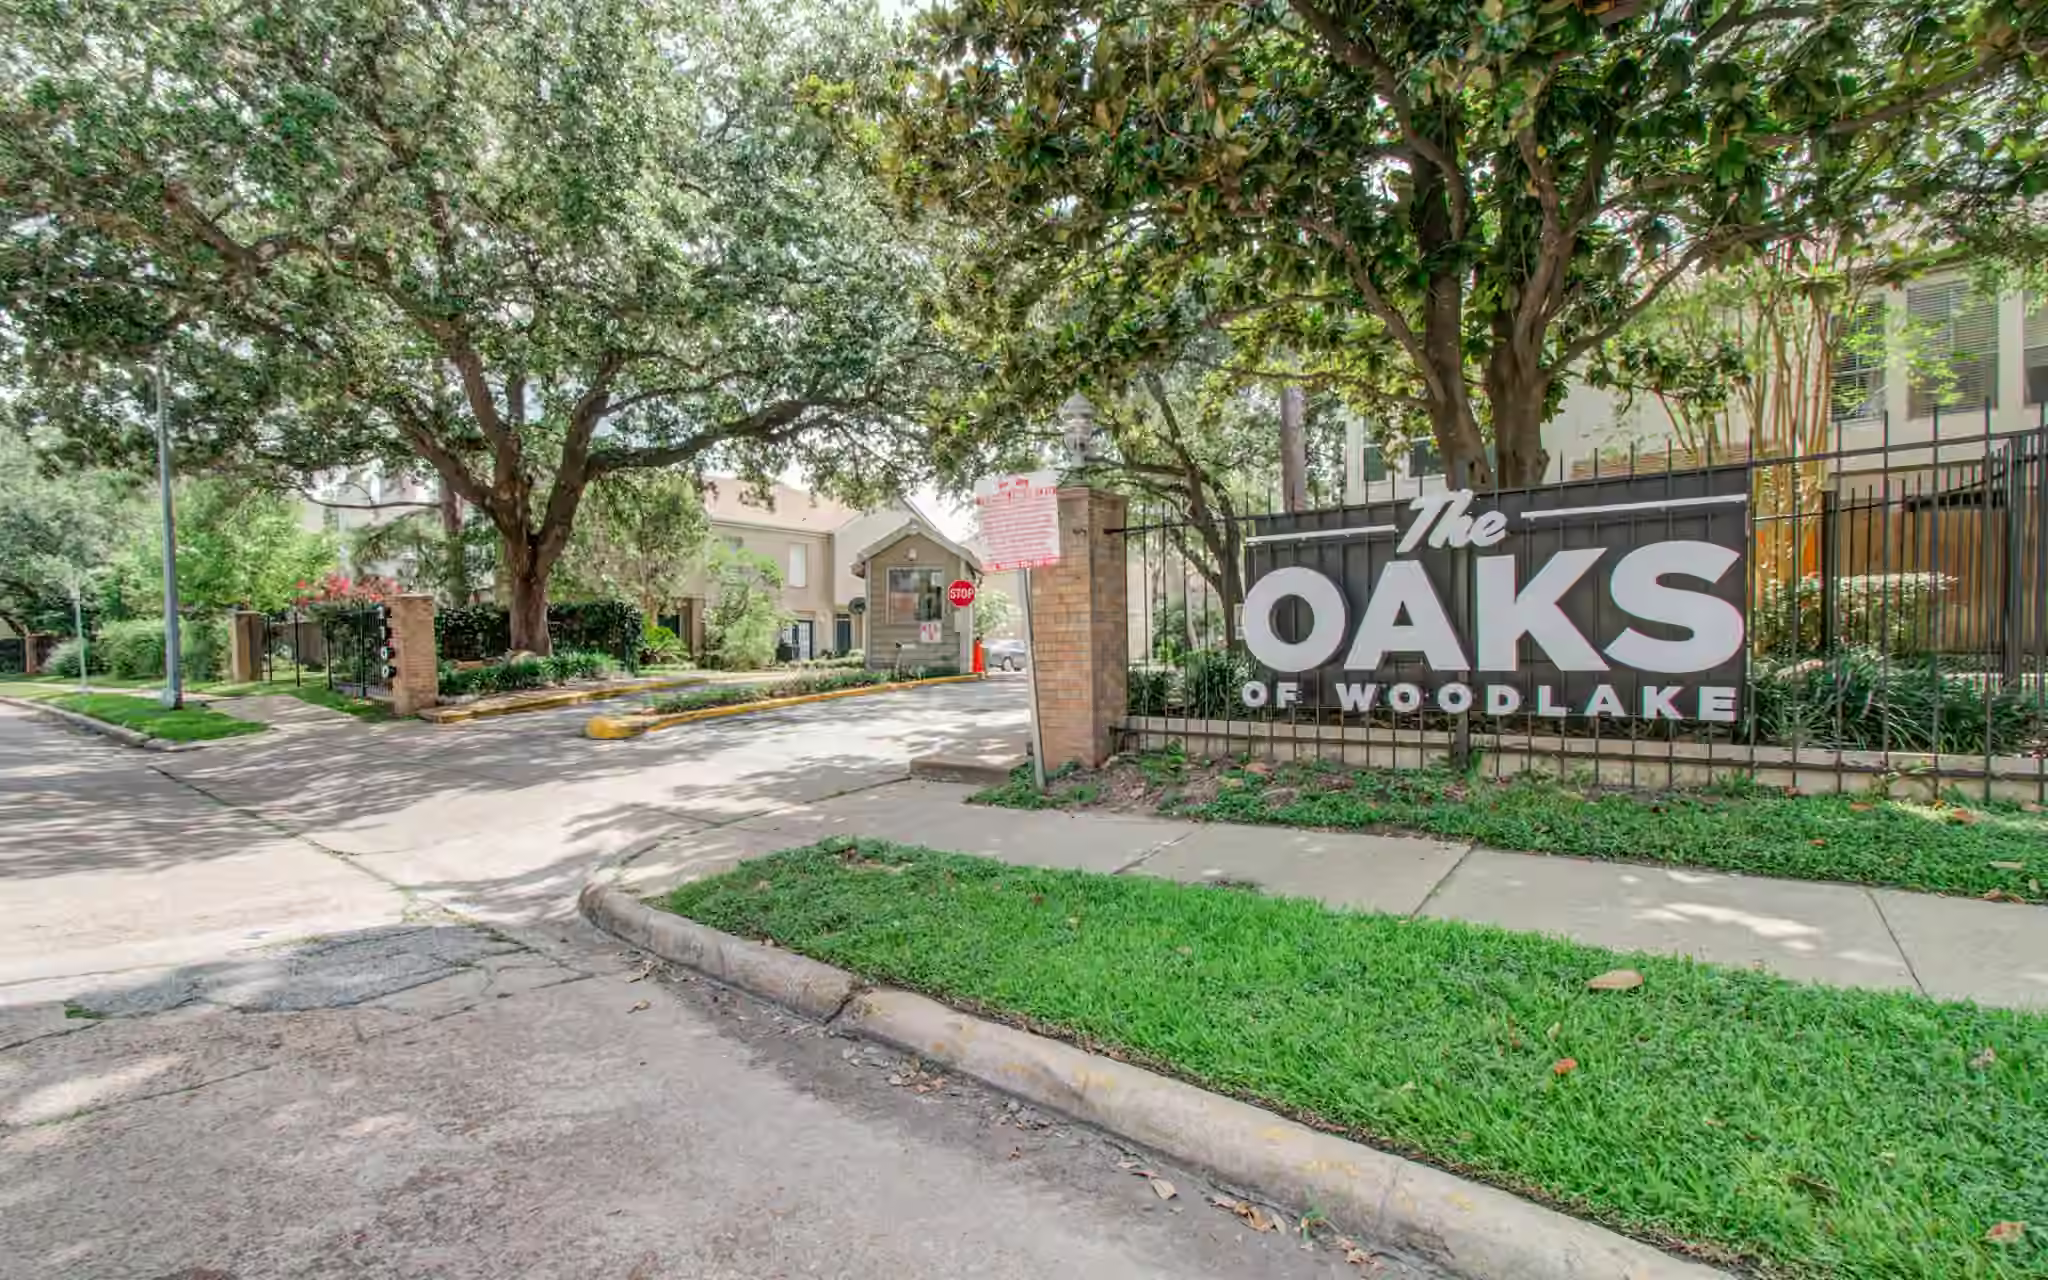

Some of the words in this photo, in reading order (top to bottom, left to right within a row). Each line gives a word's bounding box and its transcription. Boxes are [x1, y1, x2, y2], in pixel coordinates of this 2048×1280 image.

[1397, 488, 1508, 552] The
[950, 587, 974, 599] STOP
[1244, 540, 1744, 673] OAKS
[1242, 680, 1303, 708] OF
[1335, 682, 1737, 721] WOODLAKE
